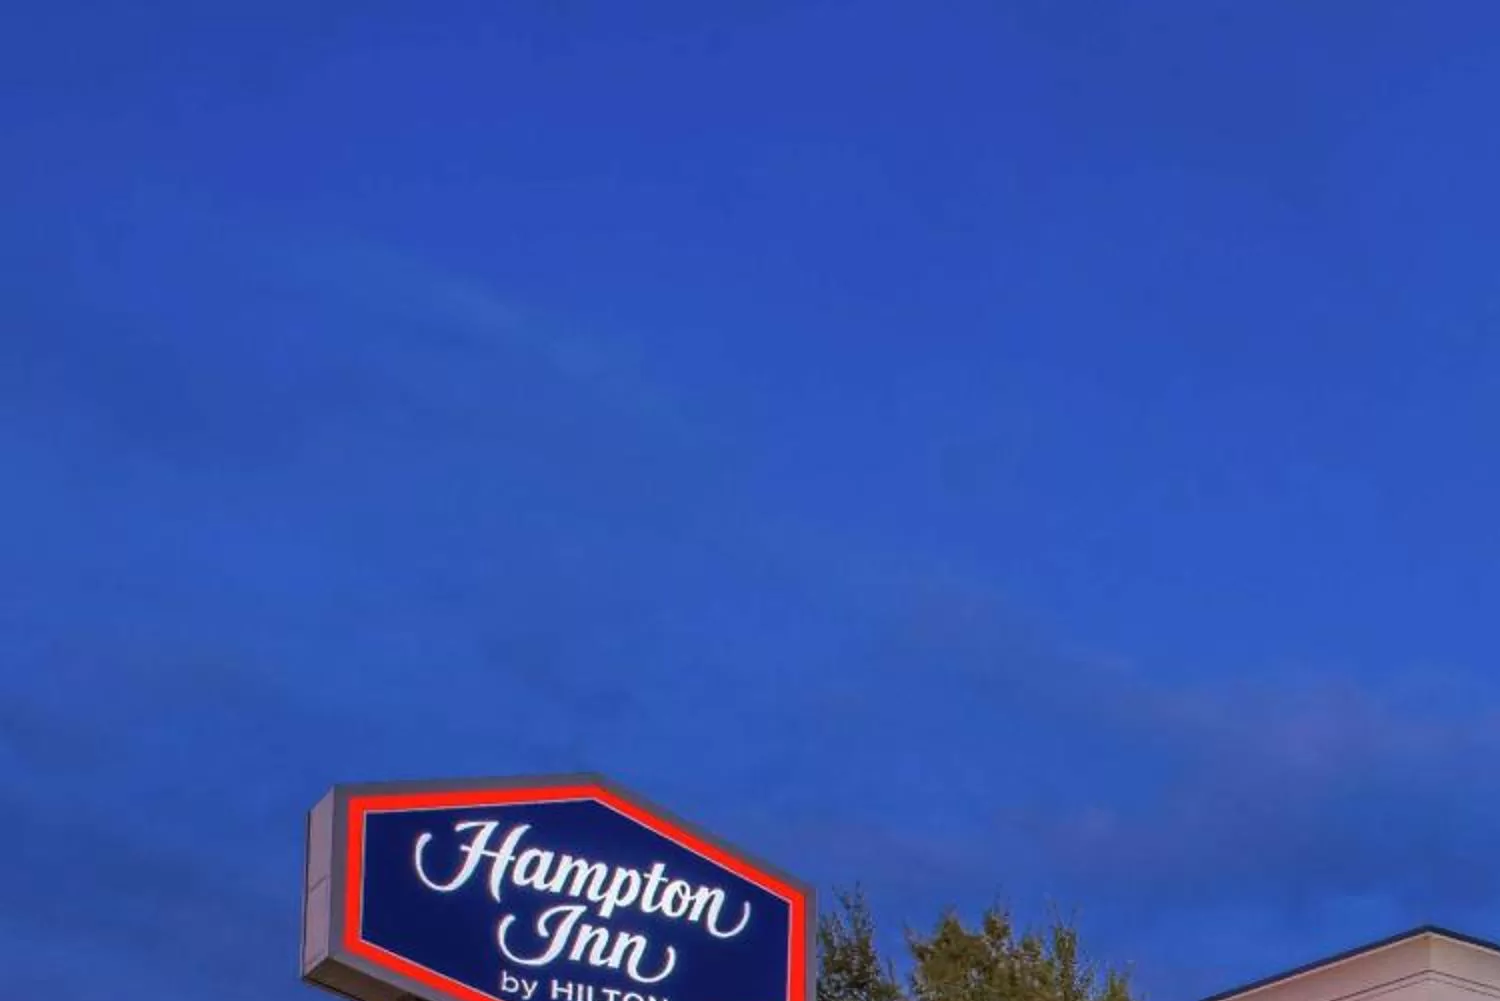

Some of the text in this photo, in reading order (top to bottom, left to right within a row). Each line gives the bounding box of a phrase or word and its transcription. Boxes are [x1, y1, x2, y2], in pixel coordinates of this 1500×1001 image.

[414, 820, 751, 939] Hampton
[498, 905, 676, 983] Inn
[501, 971, 538, 1000] by
